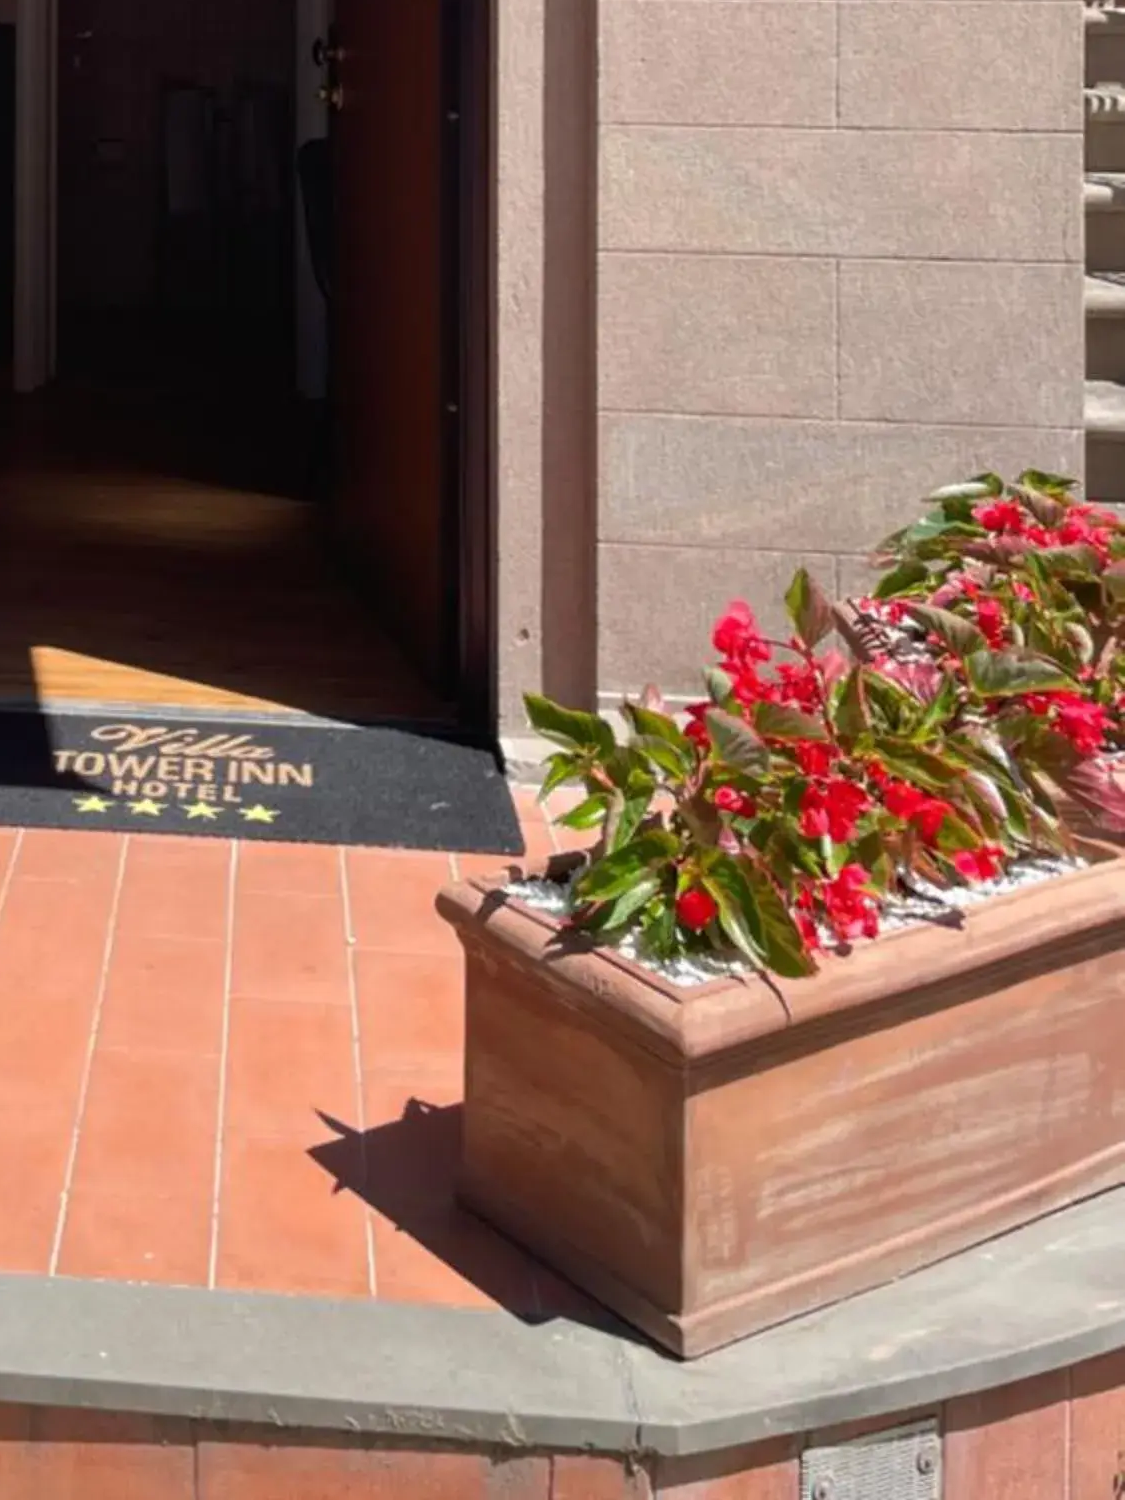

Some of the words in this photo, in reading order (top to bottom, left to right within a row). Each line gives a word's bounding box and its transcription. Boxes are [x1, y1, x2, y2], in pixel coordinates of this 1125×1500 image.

[91, 724, 275, 759] Villa
[53, 751, 215, 781] TOWER
[227, 761, 313, 787] INN
[111, 780, 243, 802] HOTEL
